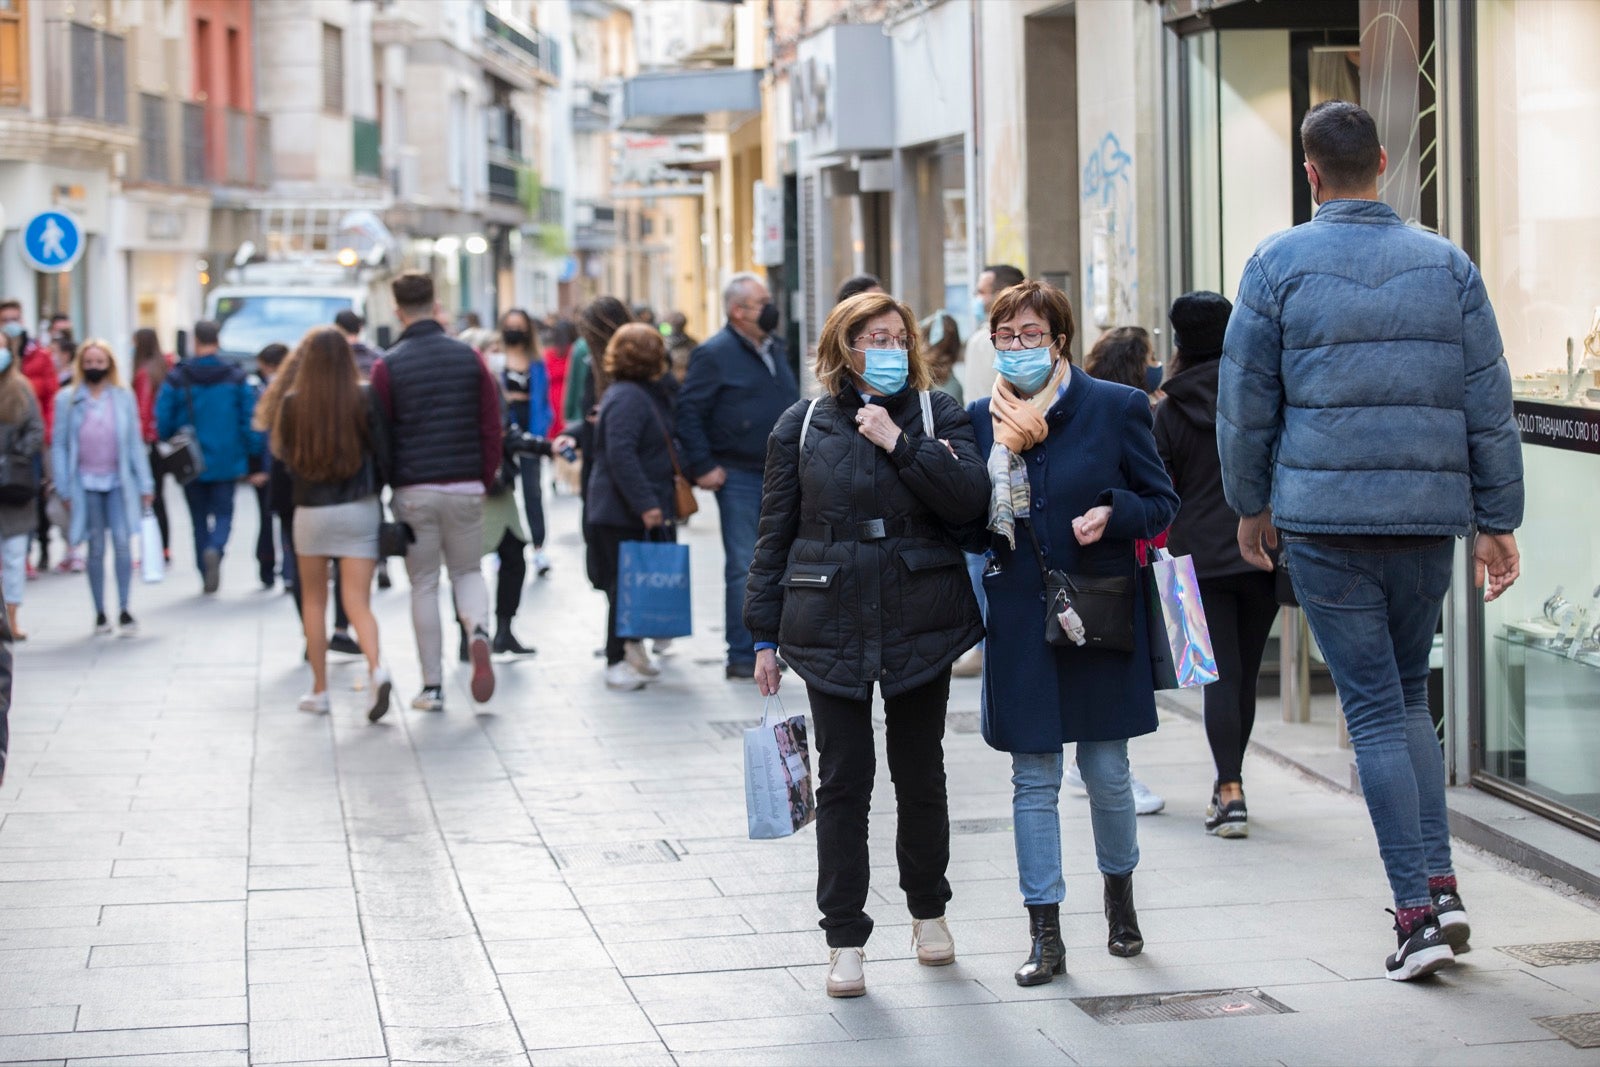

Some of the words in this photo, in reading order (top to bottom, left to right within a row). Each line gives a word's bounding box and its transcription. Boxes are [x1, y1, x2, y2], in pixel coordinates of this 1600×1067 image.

[1518, 413, 1535, 433] SOLO
[1535, 415, 1573, 440] TRABAJAMOS
[1574, 420, 1589, 440] ORO
[1590, 423, 1599, 442] 18
